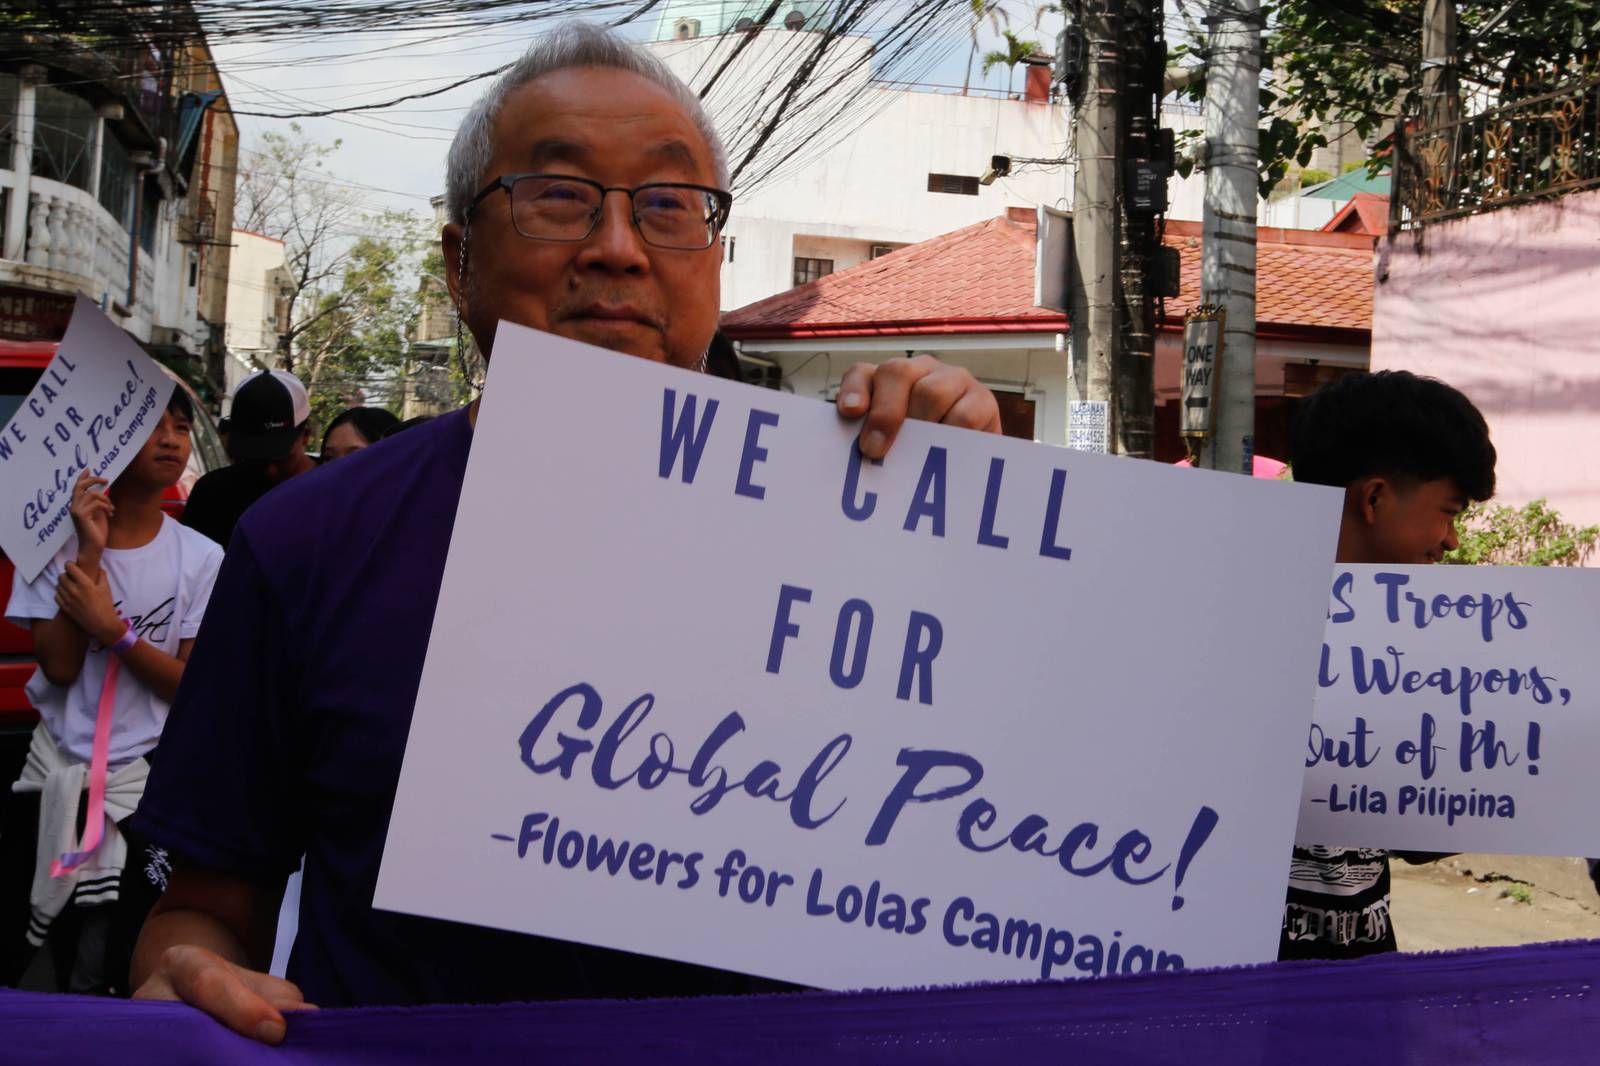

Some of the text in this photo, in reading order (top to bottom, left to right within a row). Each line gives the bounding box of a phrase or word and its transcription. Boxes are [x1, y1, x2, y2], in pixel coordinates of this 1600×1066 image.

[1185, 368, 1212, 386] WAY
[1187, 345, 1213, 363] ONE
[0, 355, 76, 461] WE CALL
[23, 360, 144, 530] Global Peace!
[43, 406, 84, 458] FOR
[36, 386, 158, 547] -Flower Lolas Campaign
[658, 387, 1072, 561] WE CALL
[766, 583, 944, 706] FOR
[1327, 571, 1532, 642] S Troops
[1350, 645, 1571, 716] Weapons,
[1395, 712, 1447, 780] of
[518, 682, 1219, 911] Global Peace!
[1311, 783, 1515, 826] -Lila Pilipina
[490, 812, 704, 890] -Flowers
[714, 849, 794, 907] for
[806, 868, 931, 935] Lolas
